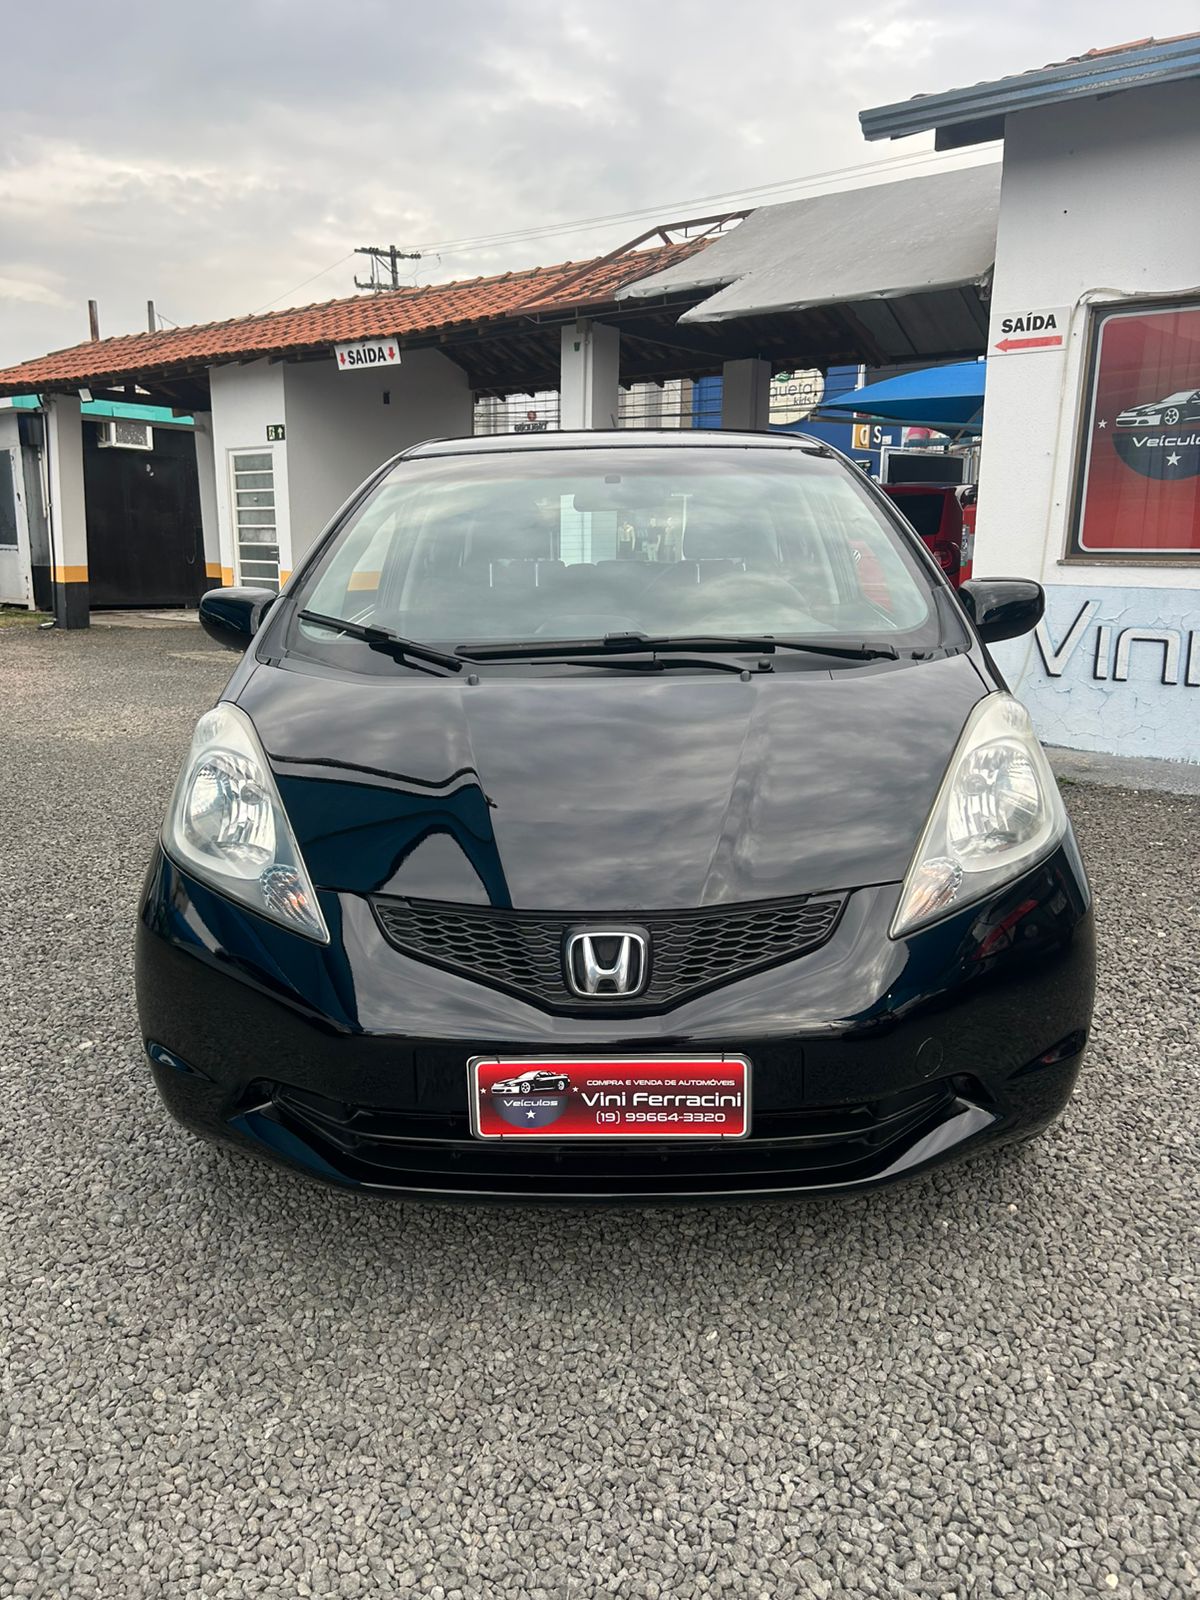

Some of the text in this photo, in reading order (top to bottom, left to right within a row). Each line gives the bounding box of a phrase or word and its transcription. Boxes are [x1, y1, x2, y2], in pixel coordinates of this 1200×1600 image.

[1001, 312, 1057, 334] SAÍDA
[347, 343, 387, 365] SAÍDA
[677, 1078, 735, 1086] AUTOMÓVEIS
[503, 1099, 558, 1107] Veículos
[581, 1091, 741, 1107] Vini Ferracini
[596, 1111, 726, 1124] (19) 99664-3320
